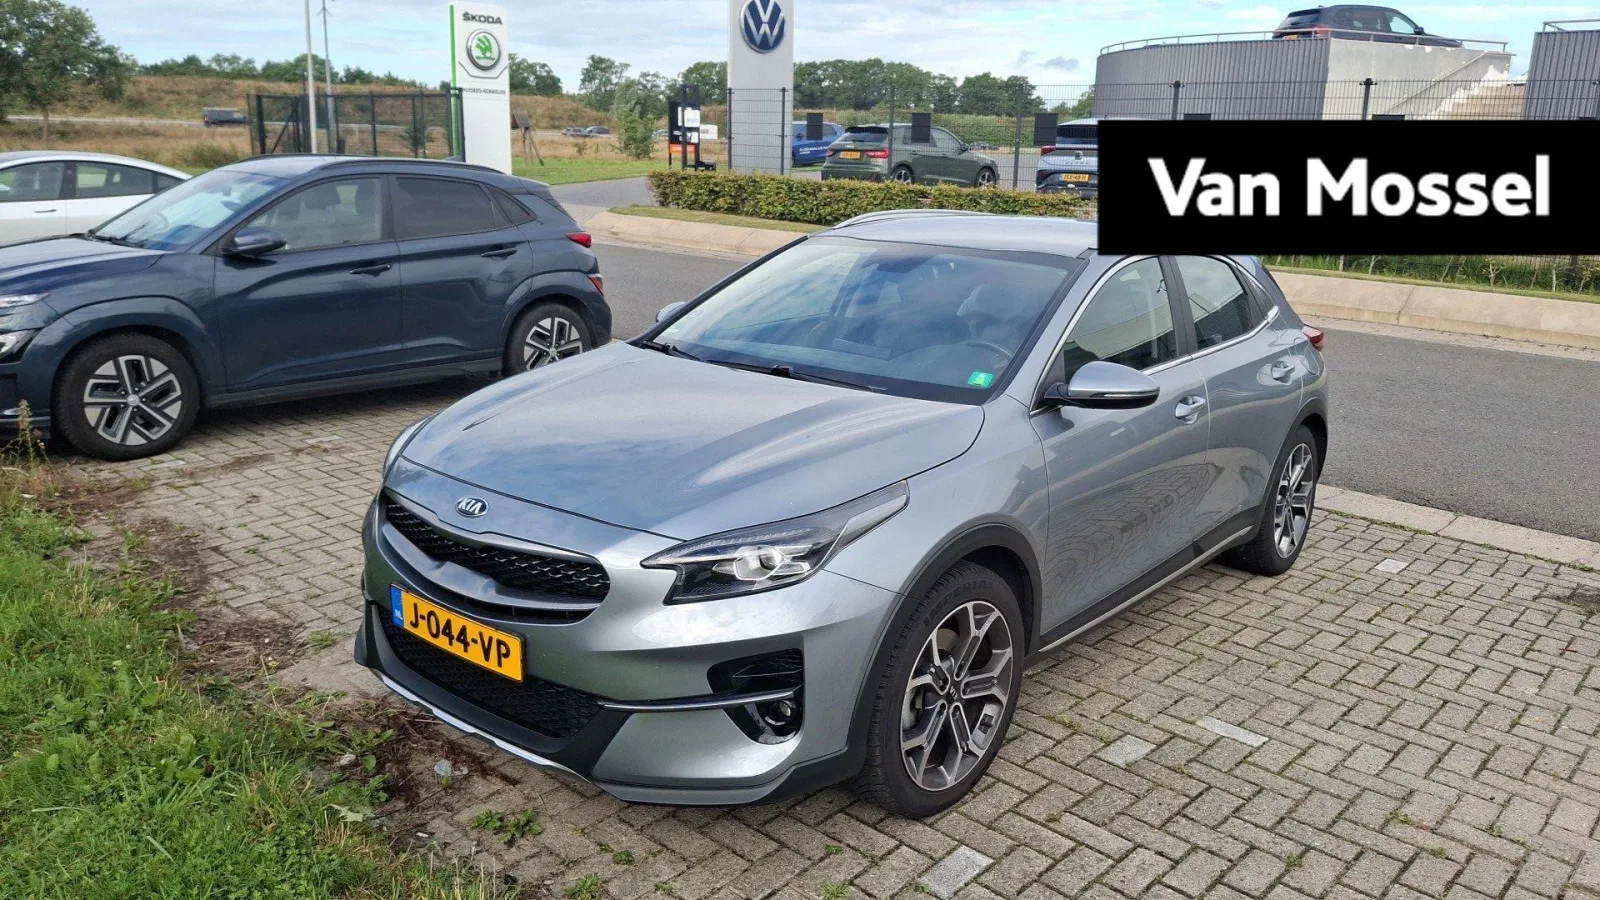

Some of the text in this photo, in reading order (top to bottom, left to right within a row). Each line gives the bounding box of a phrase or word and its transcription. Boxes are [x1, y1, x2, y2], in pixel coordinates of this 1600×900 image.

[462, 11, 503, 25] ŠKODA
[458, 497, 481, 515] KIA
[409, 602, 512, 669] J-044-VP
